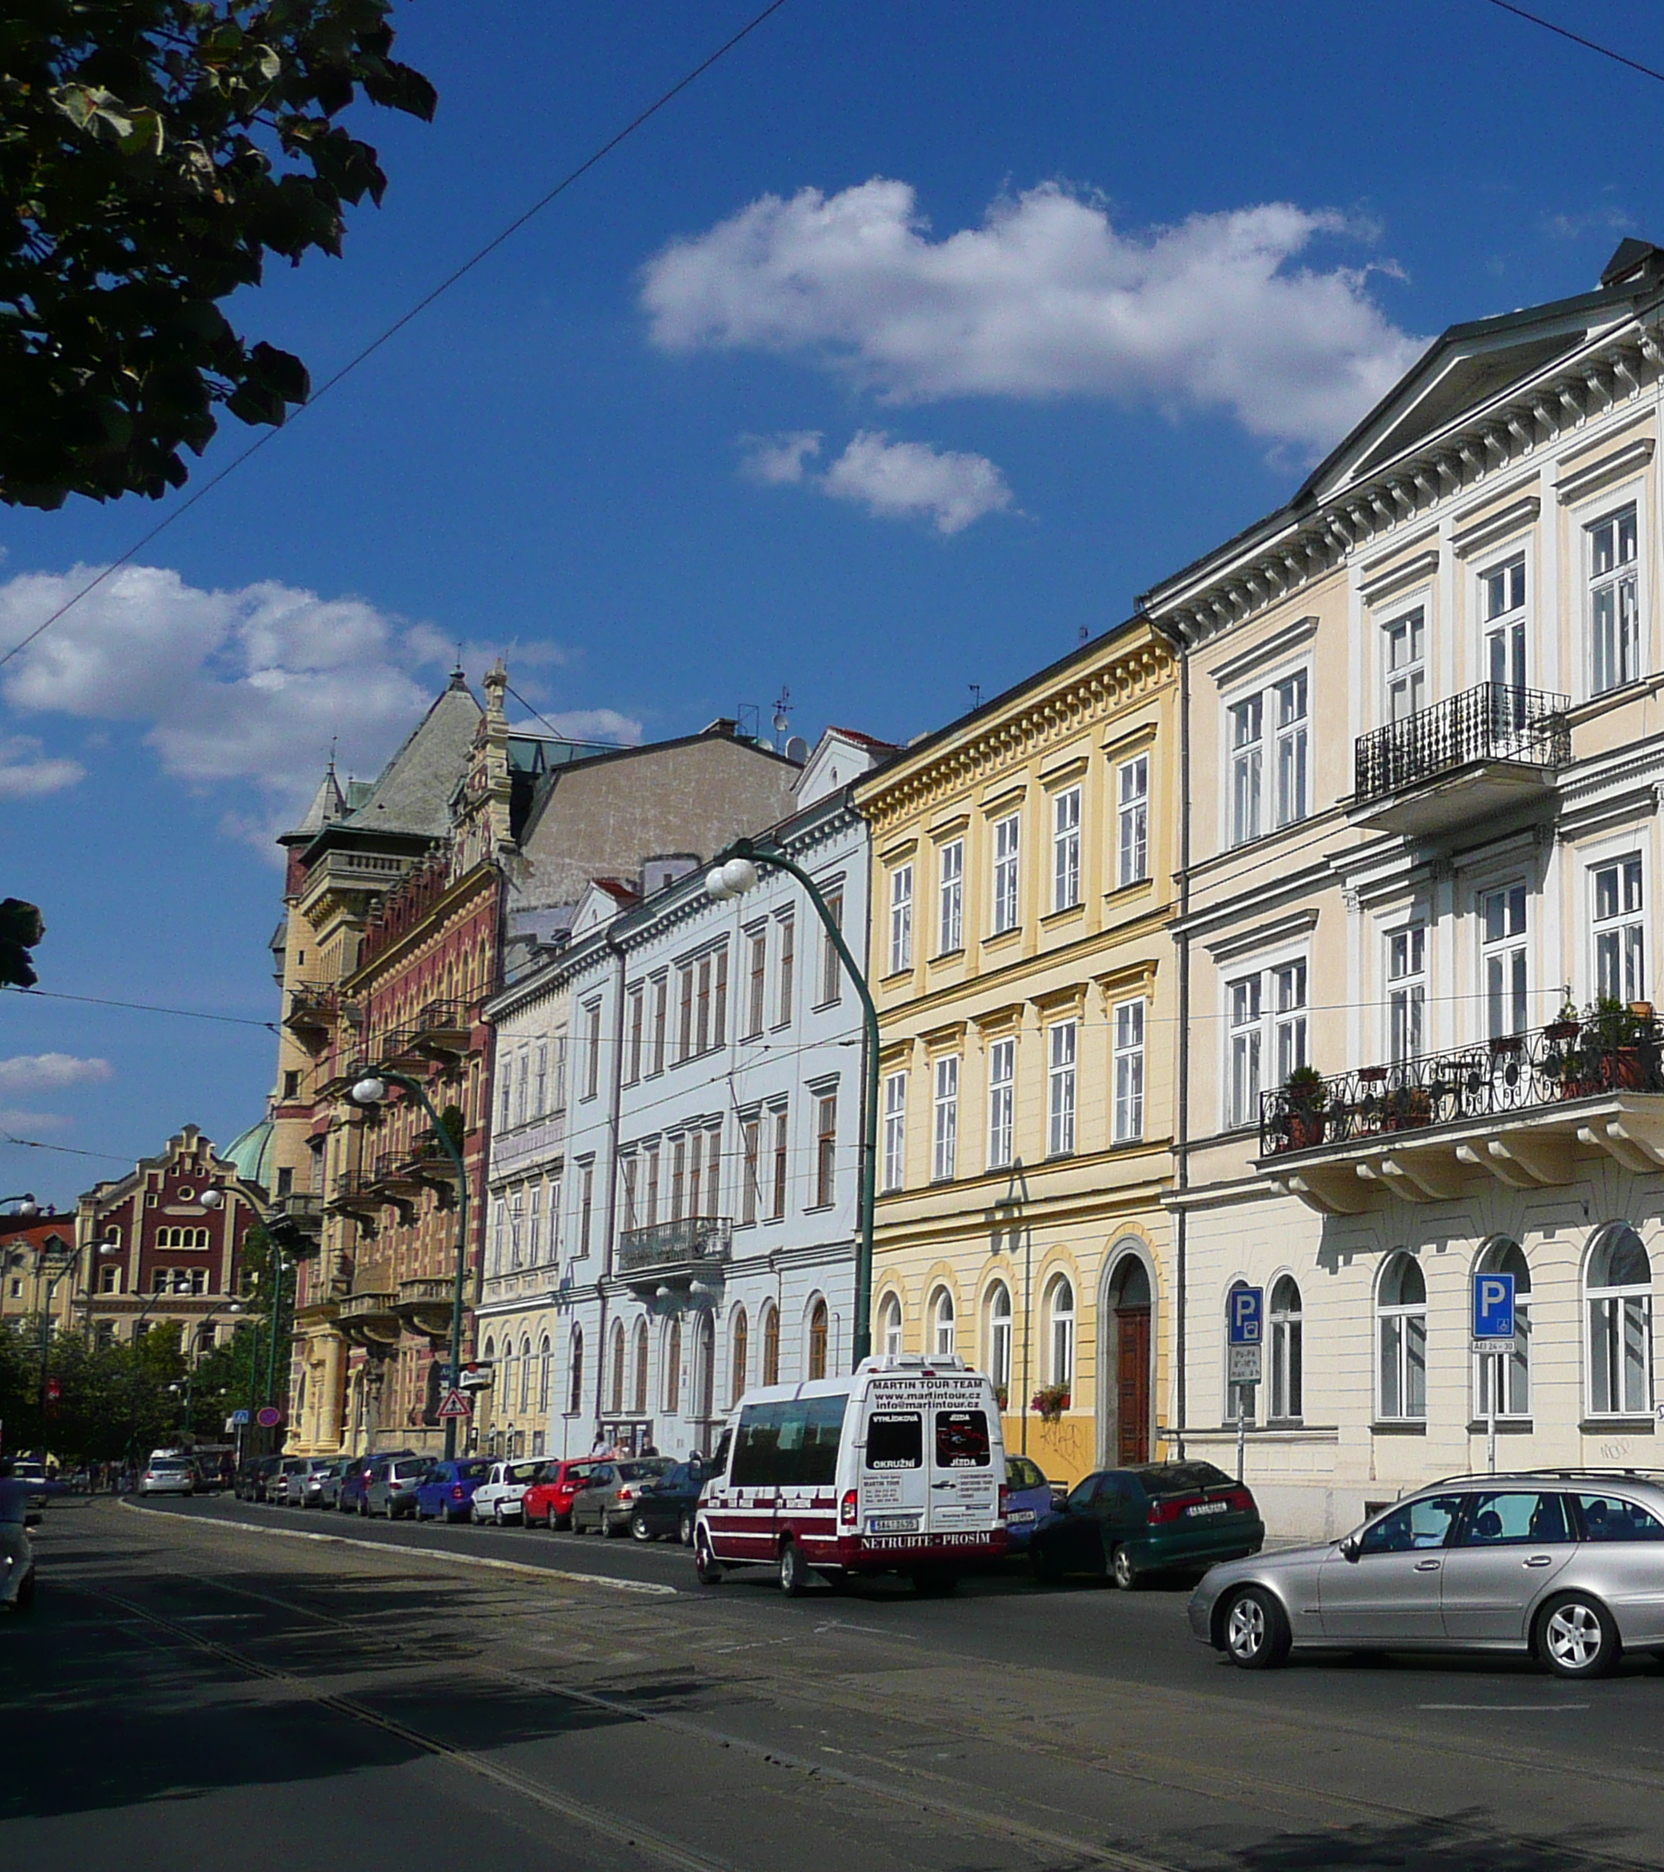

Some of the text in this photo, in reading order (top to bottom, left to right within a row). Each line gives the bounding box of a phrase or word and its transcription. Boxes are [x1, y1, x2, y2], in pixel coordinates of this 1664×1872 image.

[1481, 1281, 1506, 1317] P
[1236, 1295, 1256, 1327] P
[873, 1380, 983, 1390] MARTIN TOUR TEAM
[875, 1391, 981, 1400] www.martintour.cz
[876, 1401, 980, 1410] info@martintour.cz
[873, 1458, 977, 1469] OKRUŽNÍ JÍZDA
[861, 1535, 934, 1549] NETRUBTE
[942, 1530, 991, 1545] PROSÍM
